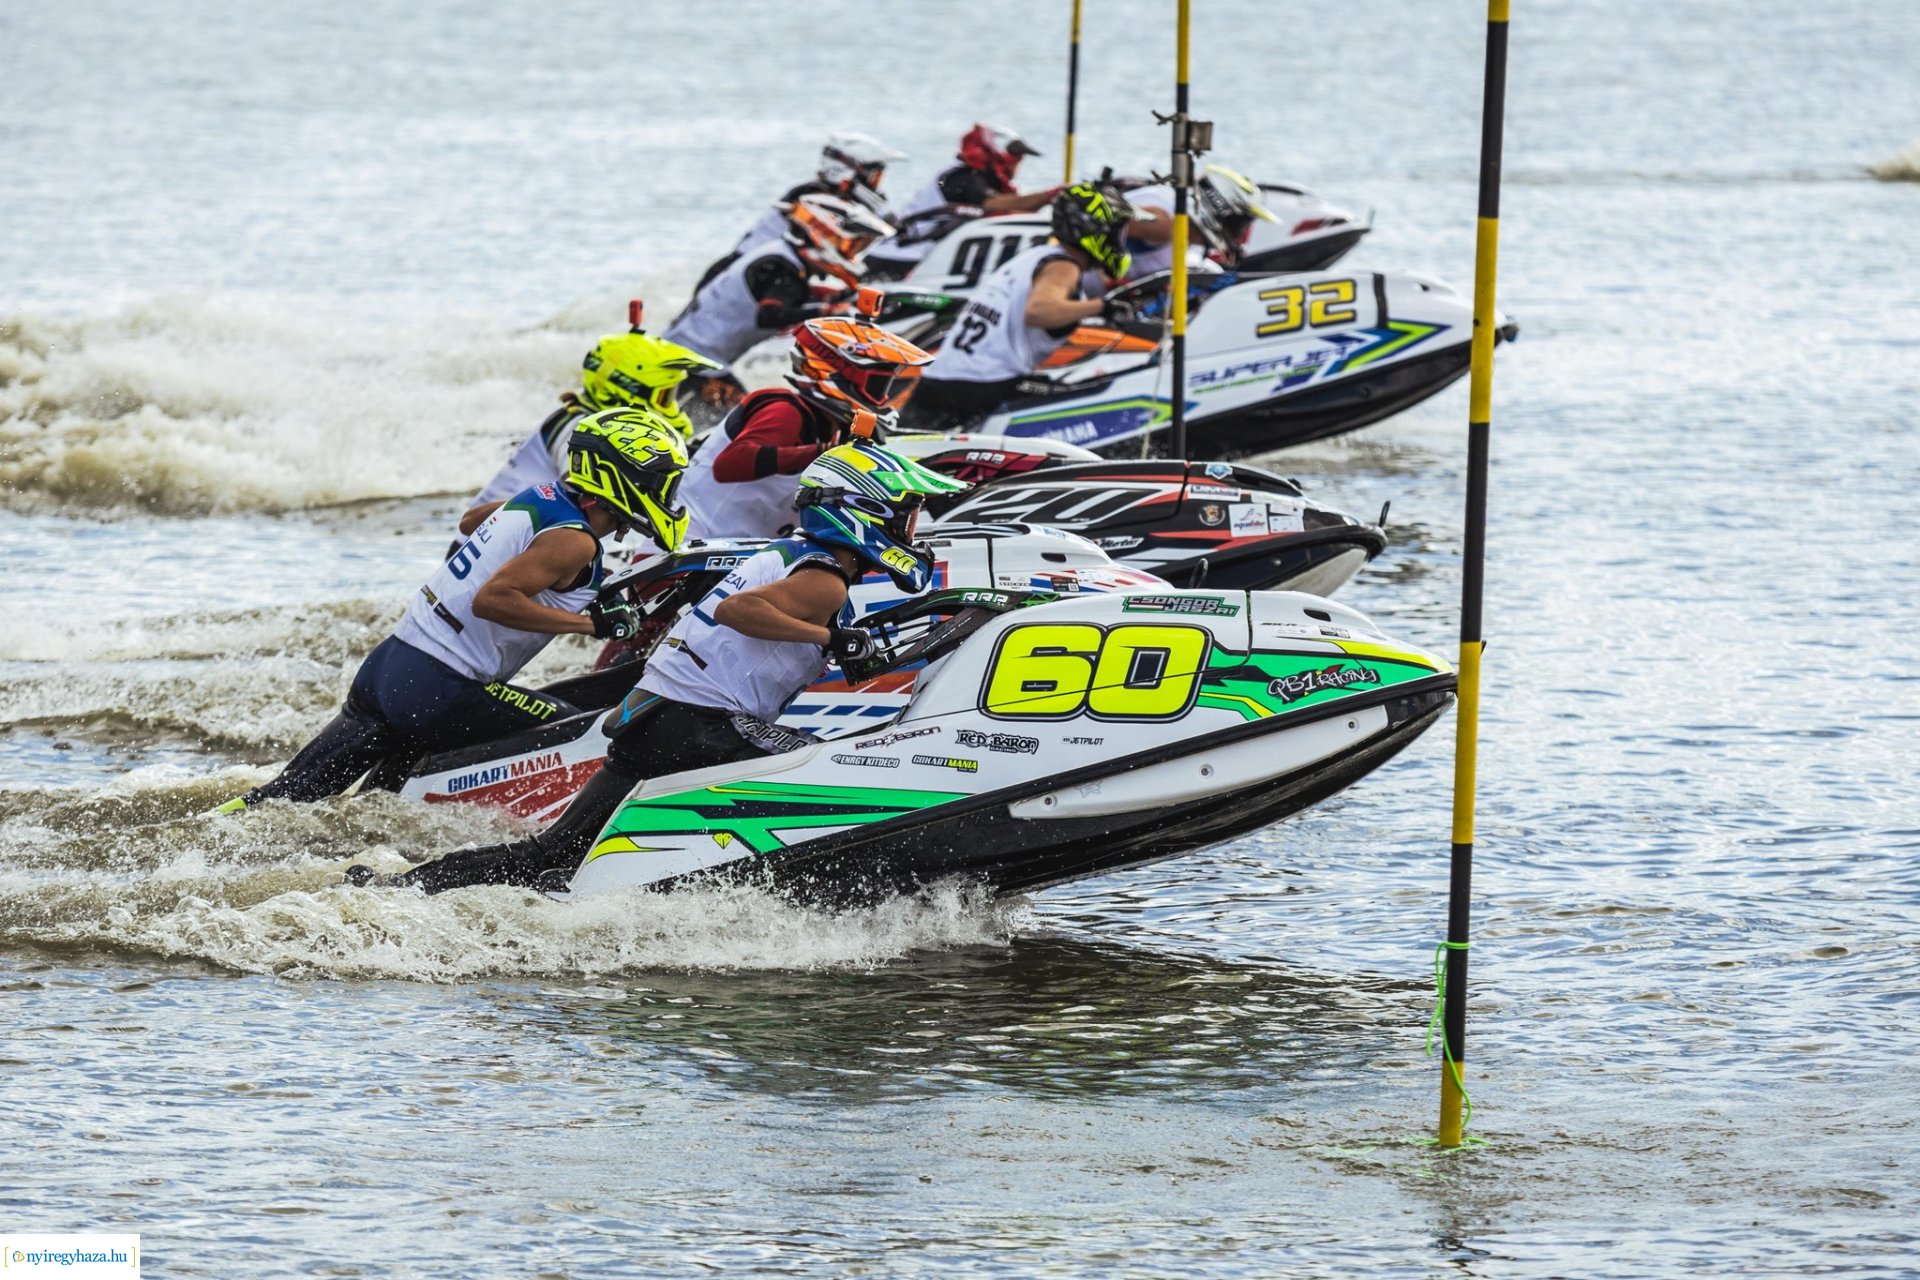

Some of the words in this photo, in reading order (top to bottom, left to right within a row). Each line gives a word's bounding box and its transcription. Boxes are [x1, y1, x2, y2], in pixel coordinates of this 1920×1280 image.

[1257, 279, 1357, 338] 32
[881, 547, 917, 575] 60
[724, 572, 748, 591] ZAI
[977, 621, 1214, 724] 60
[1268, 672, 1317, 701] QB1
[1317, 668, 1377, 687] RACING
[484, 682, 558, 720] JETPILOT
[736, 717, 810, 752] JETPILO
[855, 739, 885, 751] RED
[956, 730, 988, 748] RED
[991, 733, 1039, 755] BARON
[1070, 736, 1104, 746] JETPILOT
[840, 754, 866, 766] ENRGY
[866, 757, 900, 768] KITDECO
